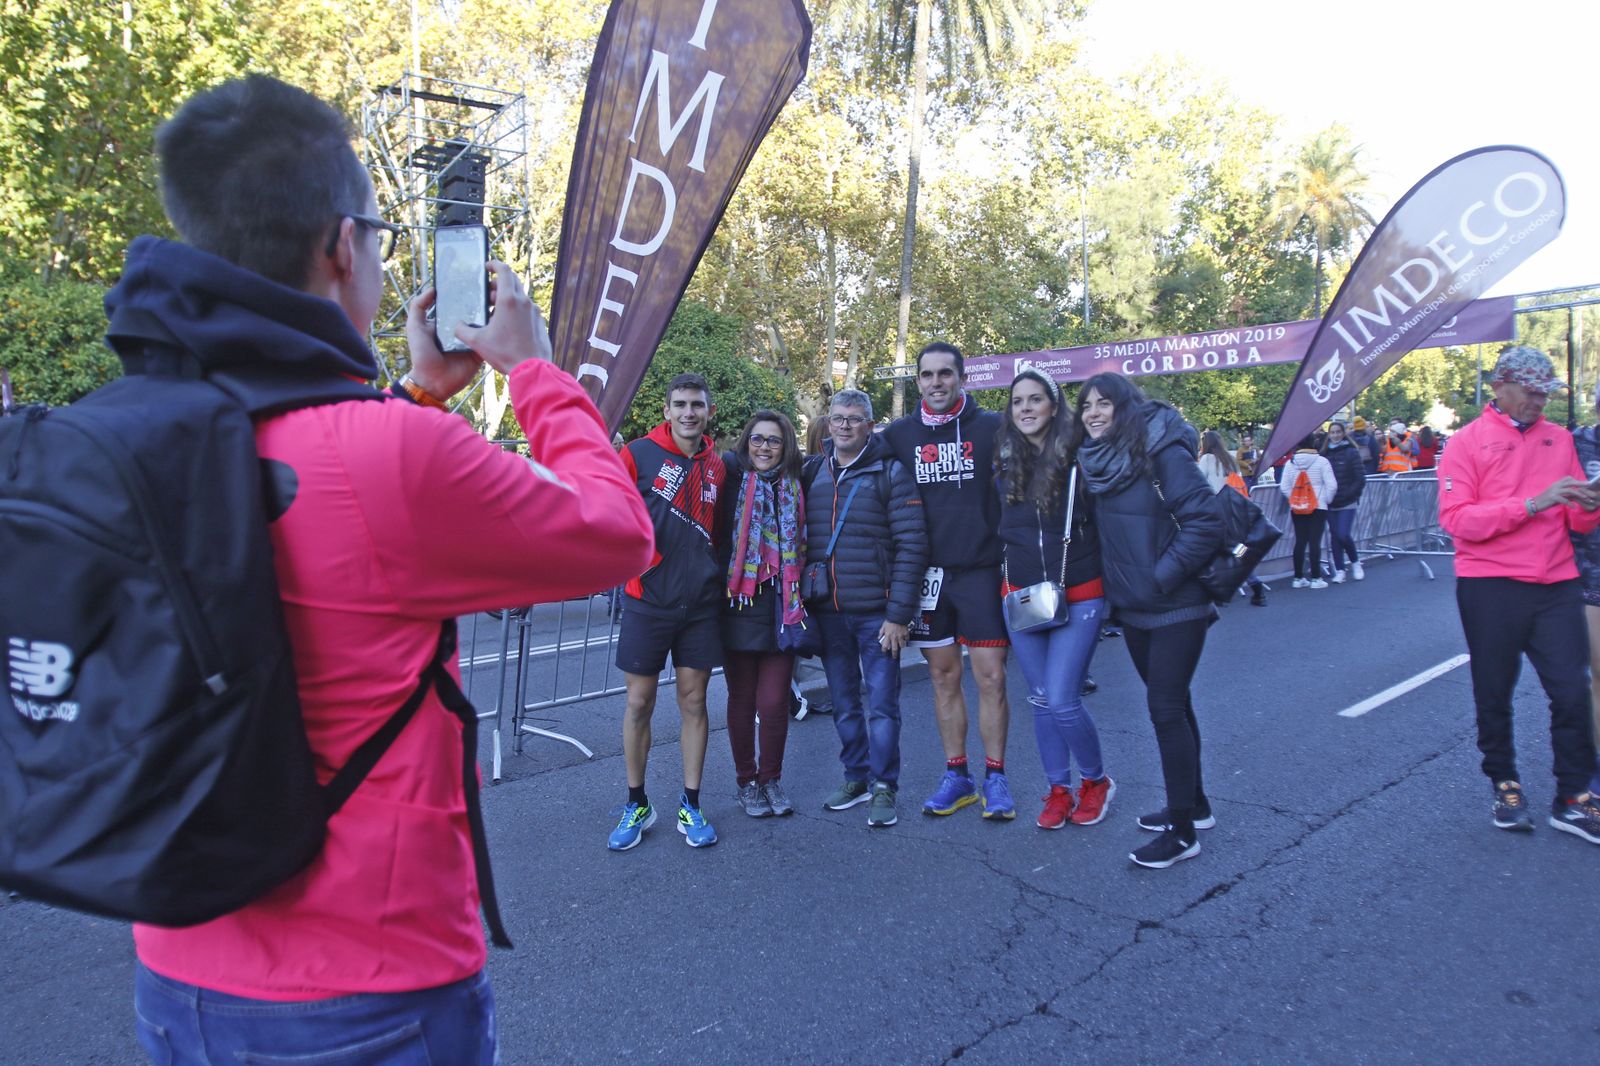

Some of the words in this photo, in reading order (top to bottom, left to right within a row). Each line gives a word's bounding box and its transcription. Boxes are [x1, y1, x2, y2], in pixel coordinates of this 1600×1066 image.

[1331, 172, 1548, 354] IMDECO
[1360, 332, 1400, 367] Instituto
[1400, 293, 1448, 335] Municipal
[1448, 282, 1463, 295] de
[1461, 245, 1510, 284] Deportes
[1094, 346, 1110, 359] 35
[1113, 340, 1161, 356] MEDIA
[1164, 331, 1240, 352] MARATÓN
[1244, 326, 1286, 343] 2019
[1035, 359, 1071, 368] Diputación
[1122, 346, 1262, 376] CÓRDOBA
[915, 459, 975, 475] RUEDAS
[916, 472, 975, 484] Bikes
[921, 578, 940, 597] 80
